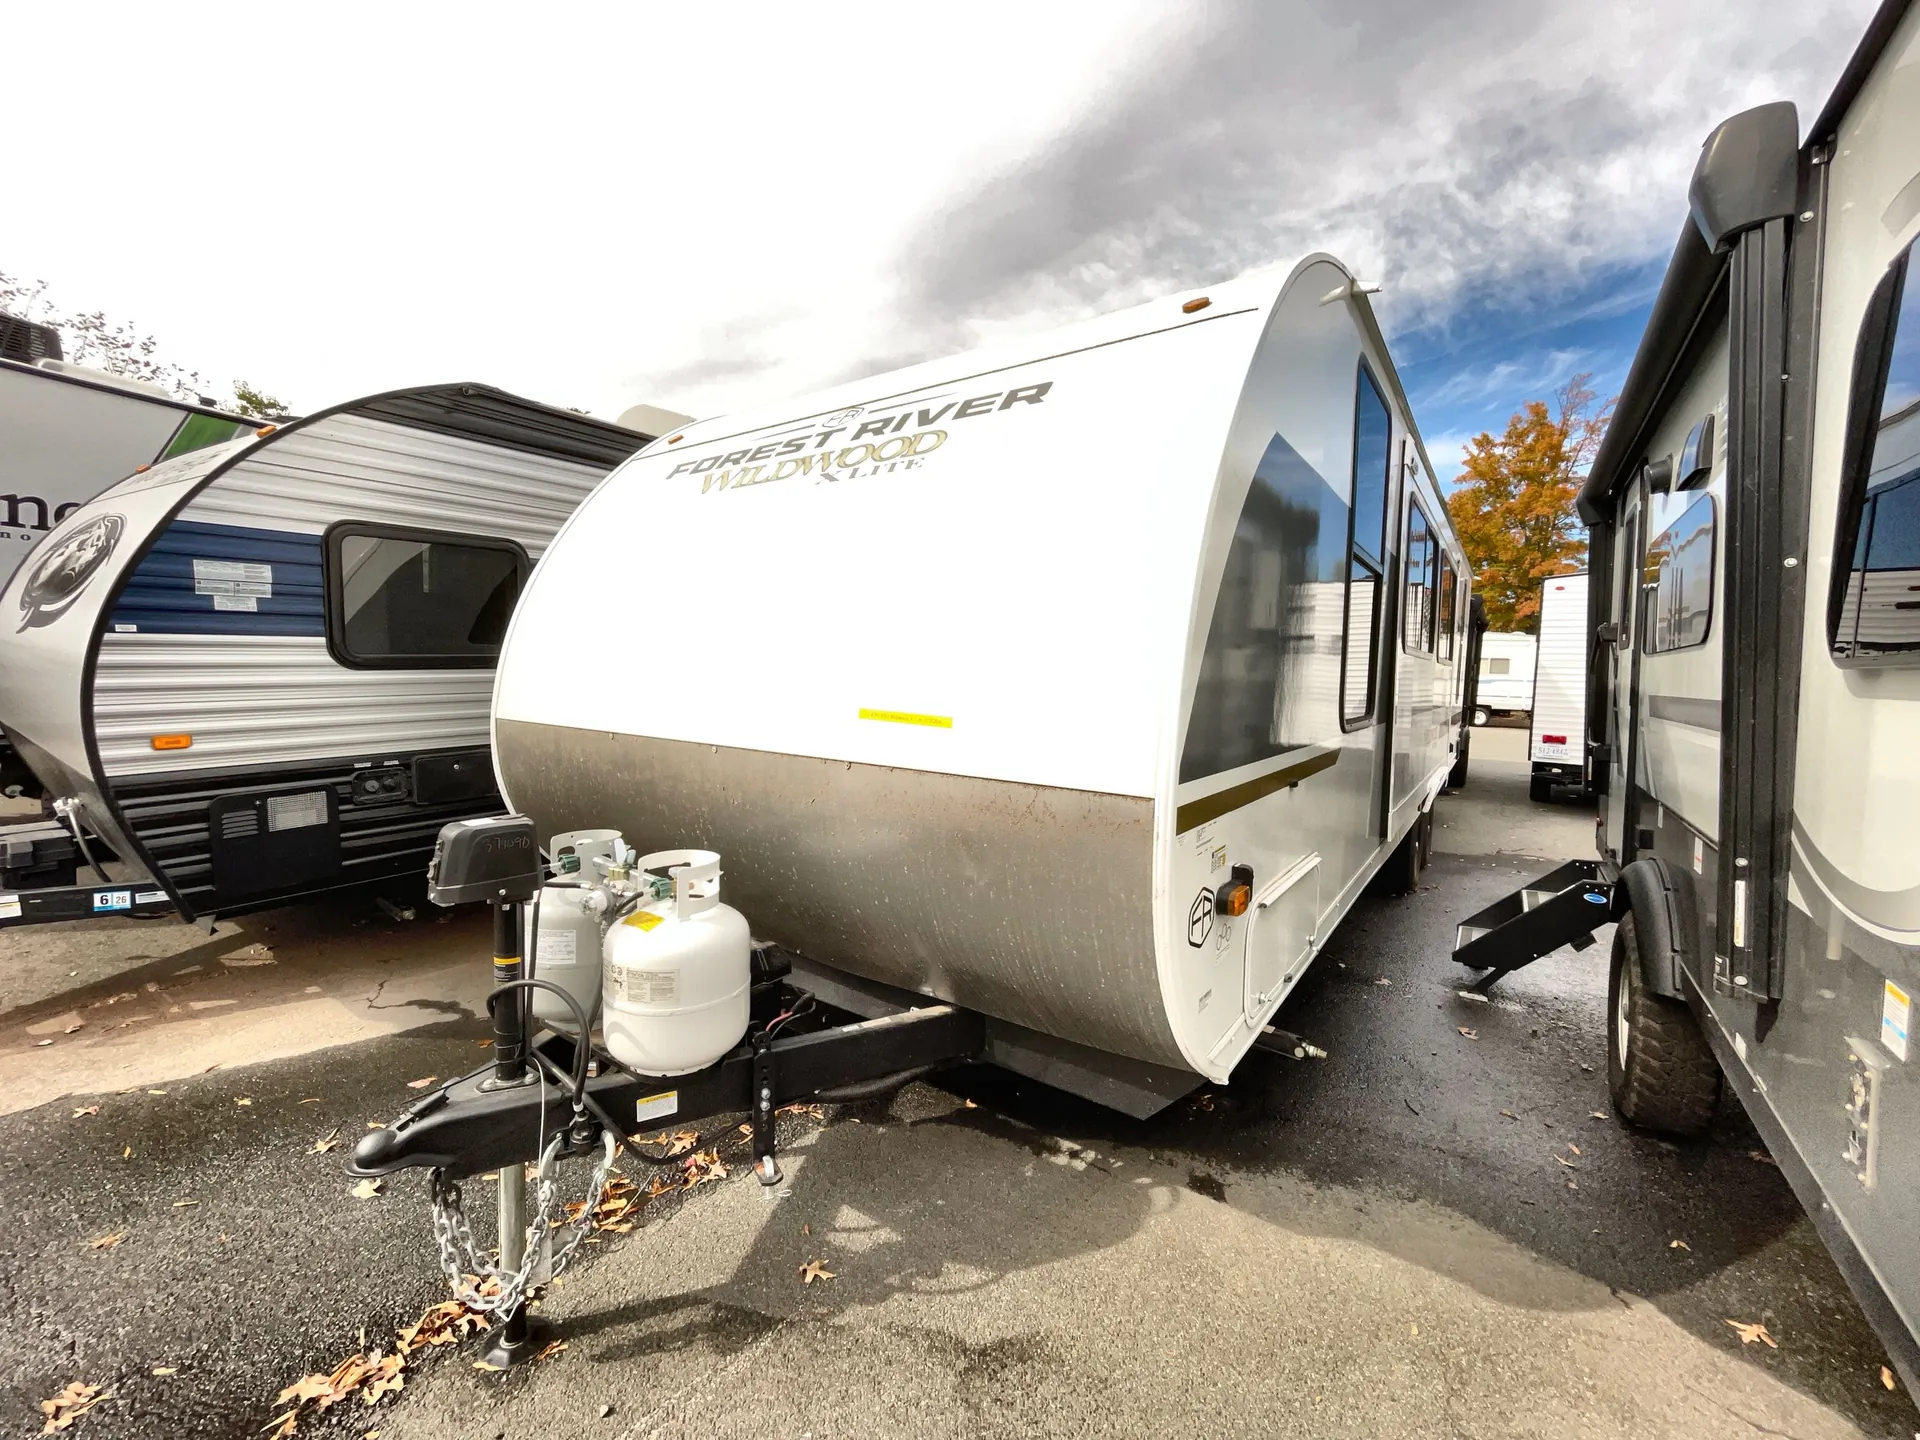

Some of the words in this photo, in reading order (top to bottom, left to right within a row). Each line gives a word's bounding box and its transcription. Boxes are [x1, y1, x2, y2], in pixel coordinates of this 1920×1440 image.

[666, 426, 847, 480] FOREST
[850, 382, 1054, 441] RIVER
[701, 430, 948, 494] WILDWOOD
[815, 470, 841, 485] X
[849, 457, 925, 479] LITE
[100, 894, 109, 906] 6
[115, 895, 127, 904] 26
